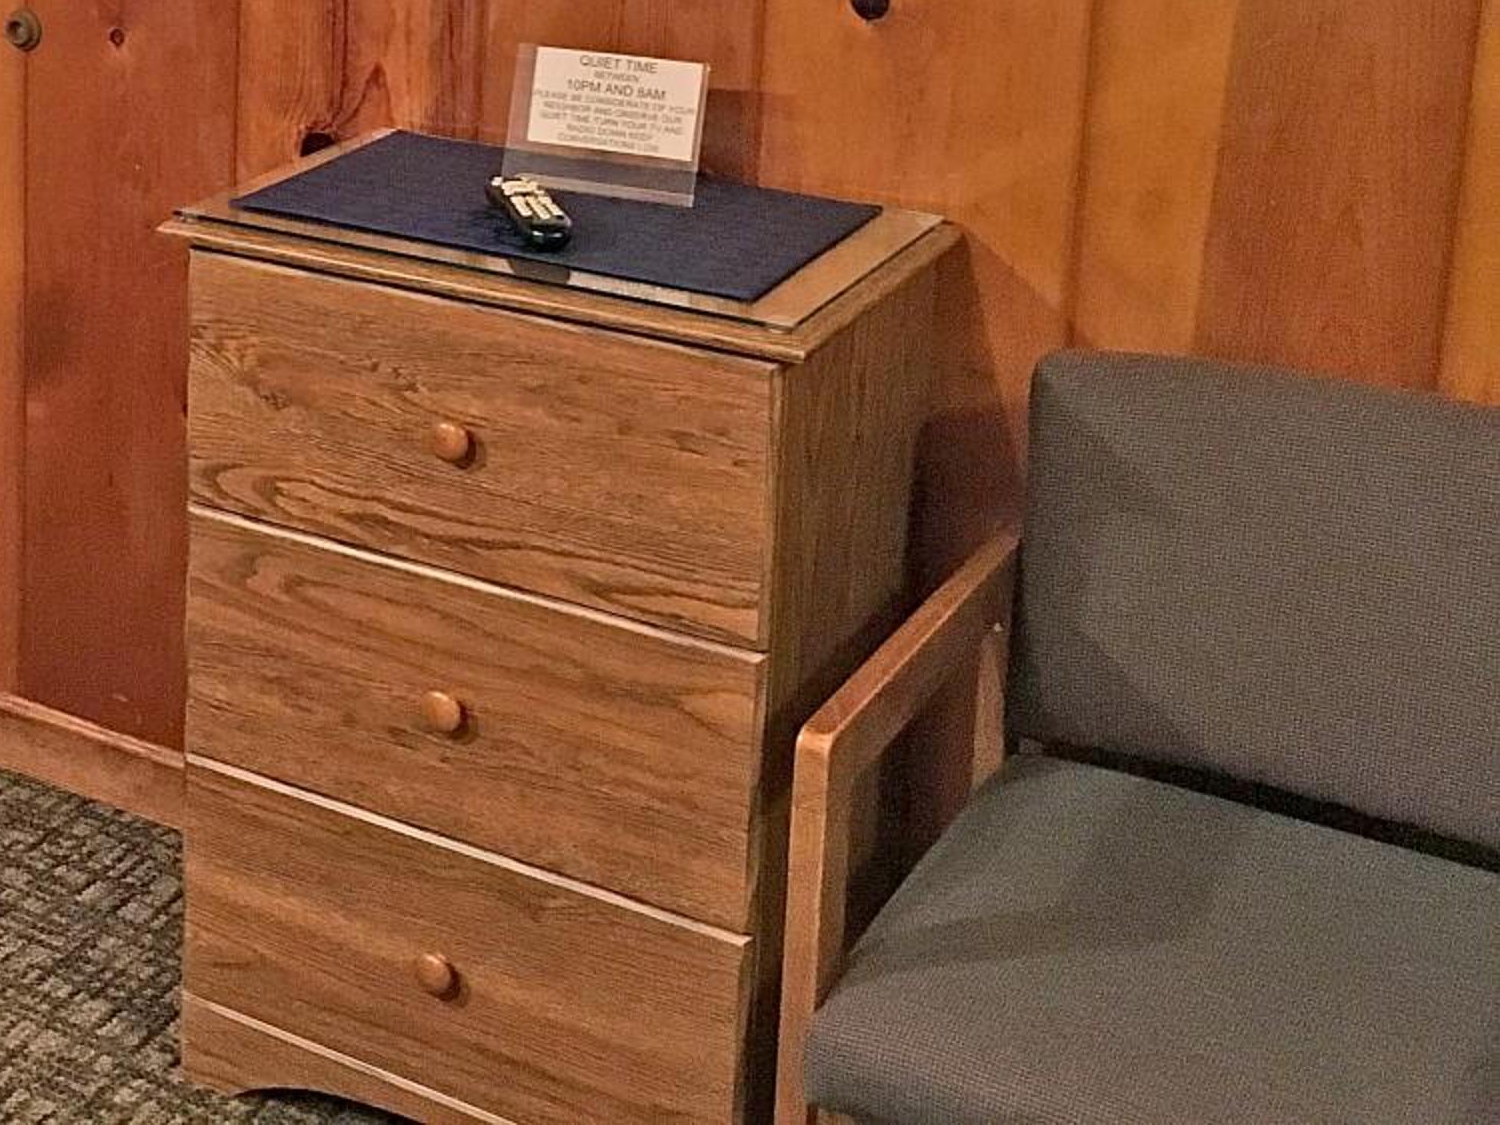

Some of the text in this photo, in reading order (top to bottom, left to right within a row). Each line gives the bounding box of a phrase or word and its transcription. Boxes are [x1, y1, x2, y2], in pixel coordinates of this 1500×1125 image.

[579, 54, 659, 74] QUIET TIME
[593, 71, 641, 83] BETWEEN
[567, 78, 601, 93] 10PM
[603, 83, 634, 97] AND
